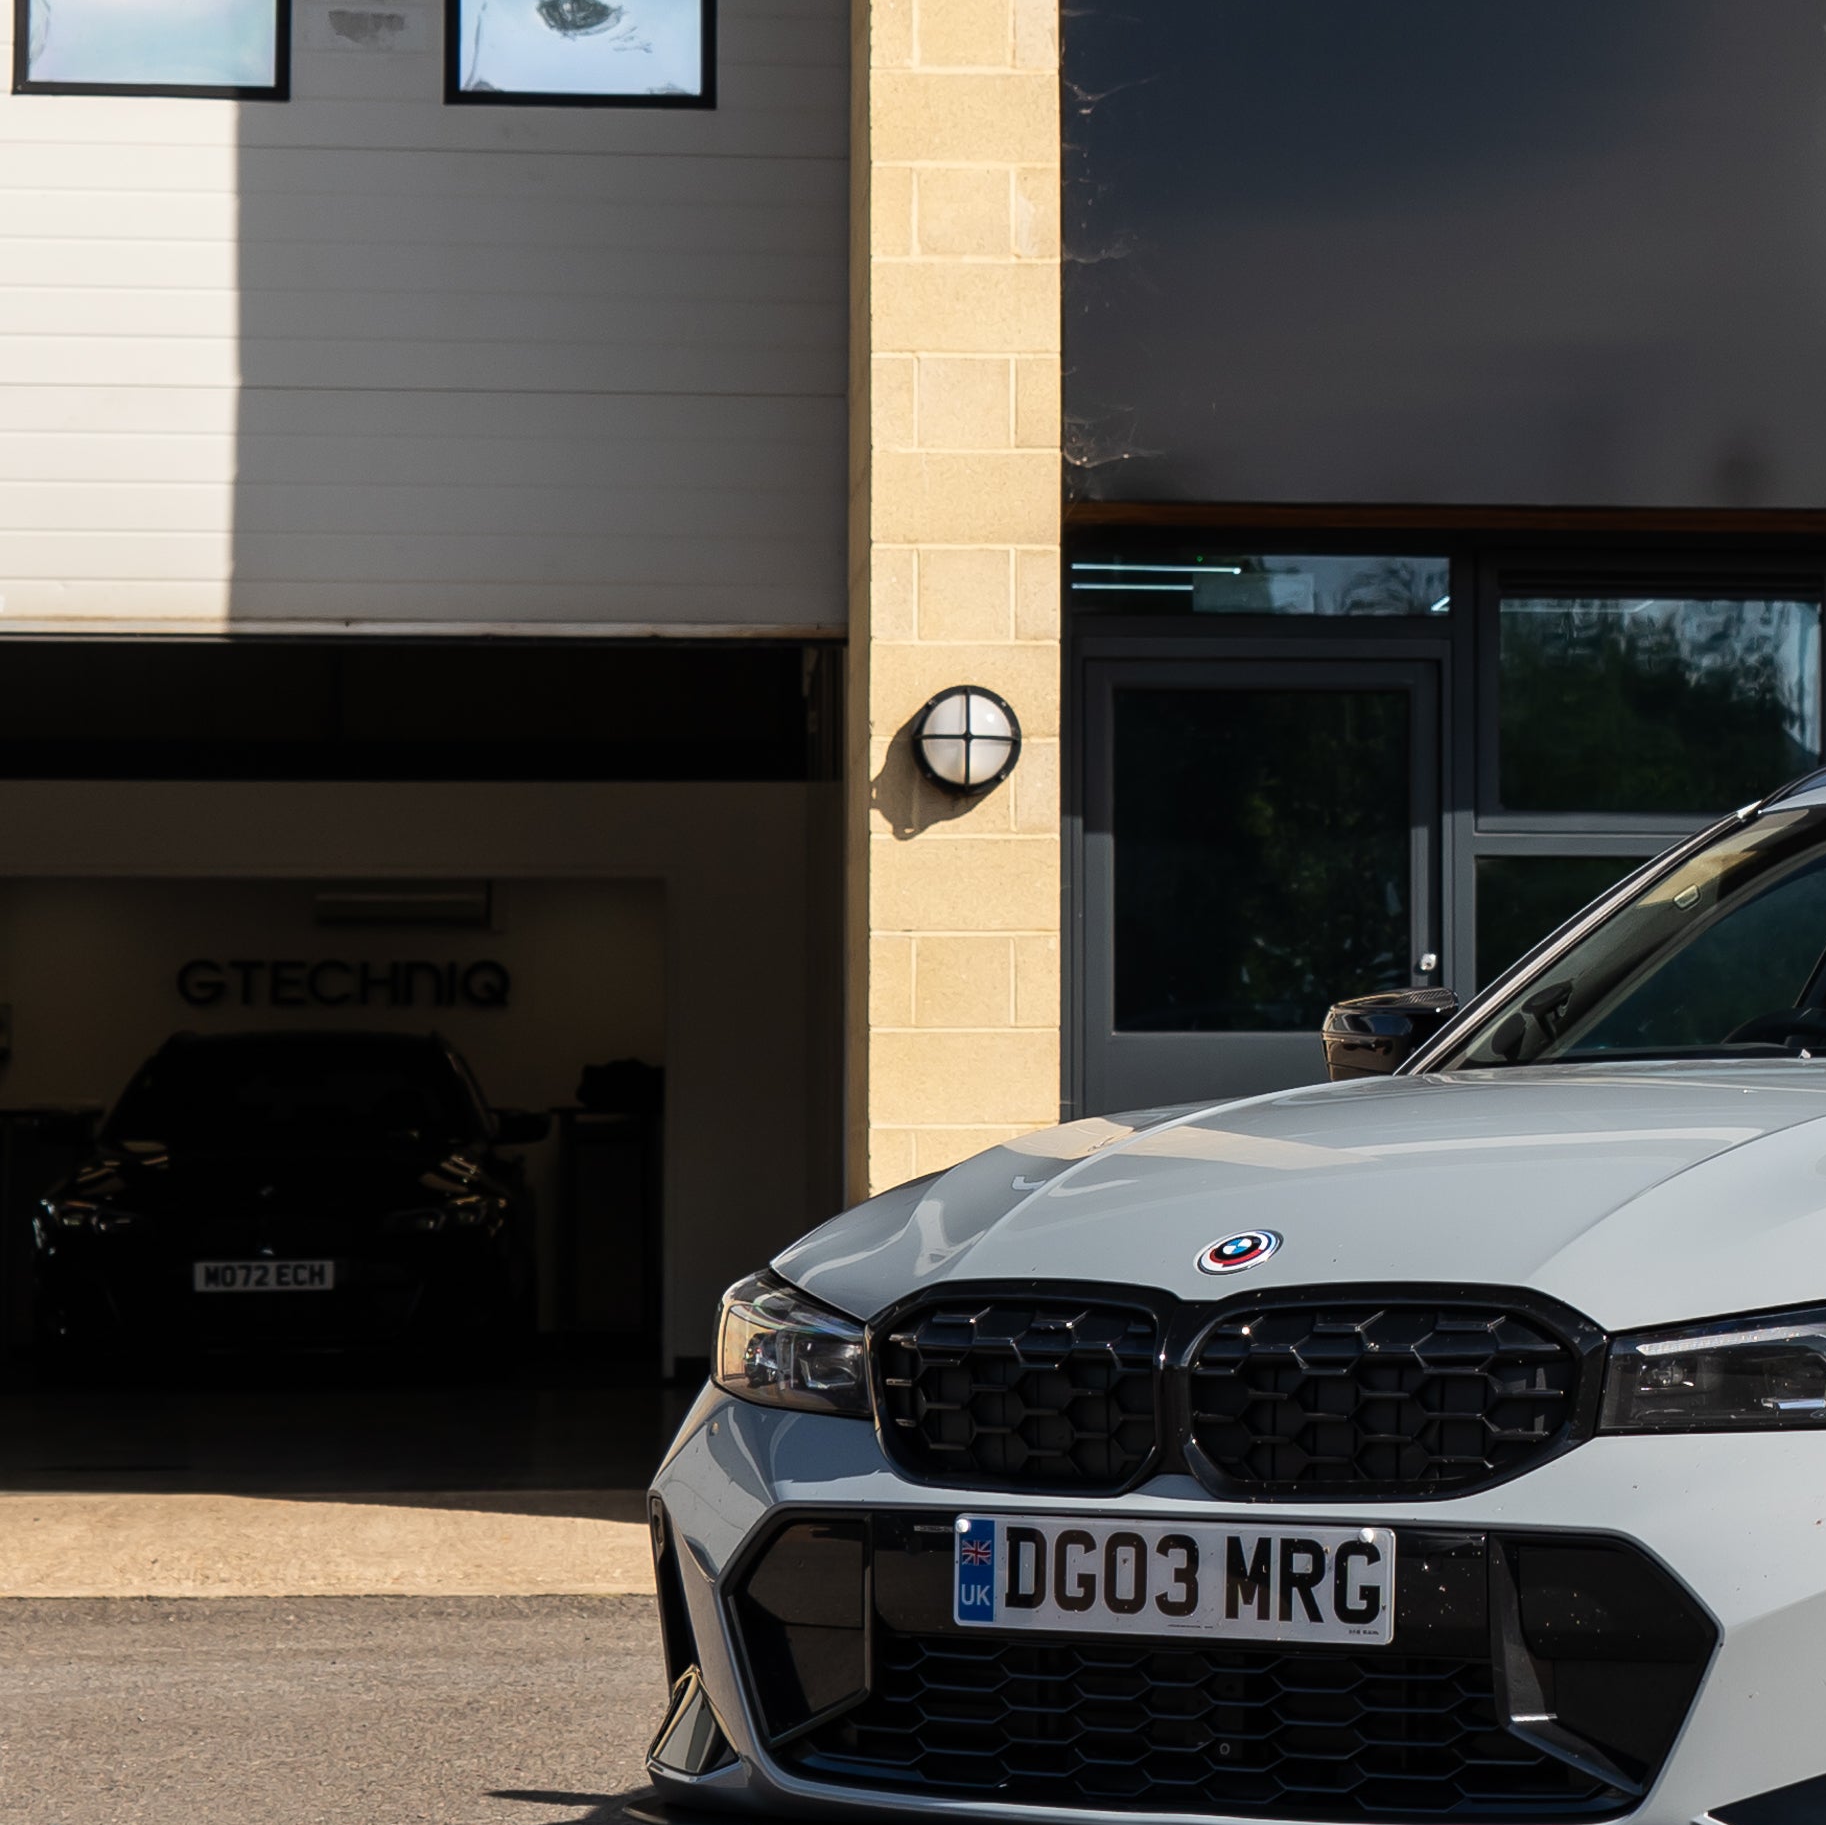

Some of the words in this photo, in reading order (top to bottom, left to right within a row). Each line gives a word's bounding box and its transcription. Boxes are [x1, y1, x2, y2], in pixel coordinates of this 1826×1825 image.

[177, 958, 512, 1010] GTECHNIQ
[204, 1265, 270, 1288] MO72
[276, 1264, 326, 1286] ECH
[1004, 1526, 1199, 1617] DG03
[1225, 1535, 1382, 1625] MRG
[960, 1583, 991, 1607] UK
